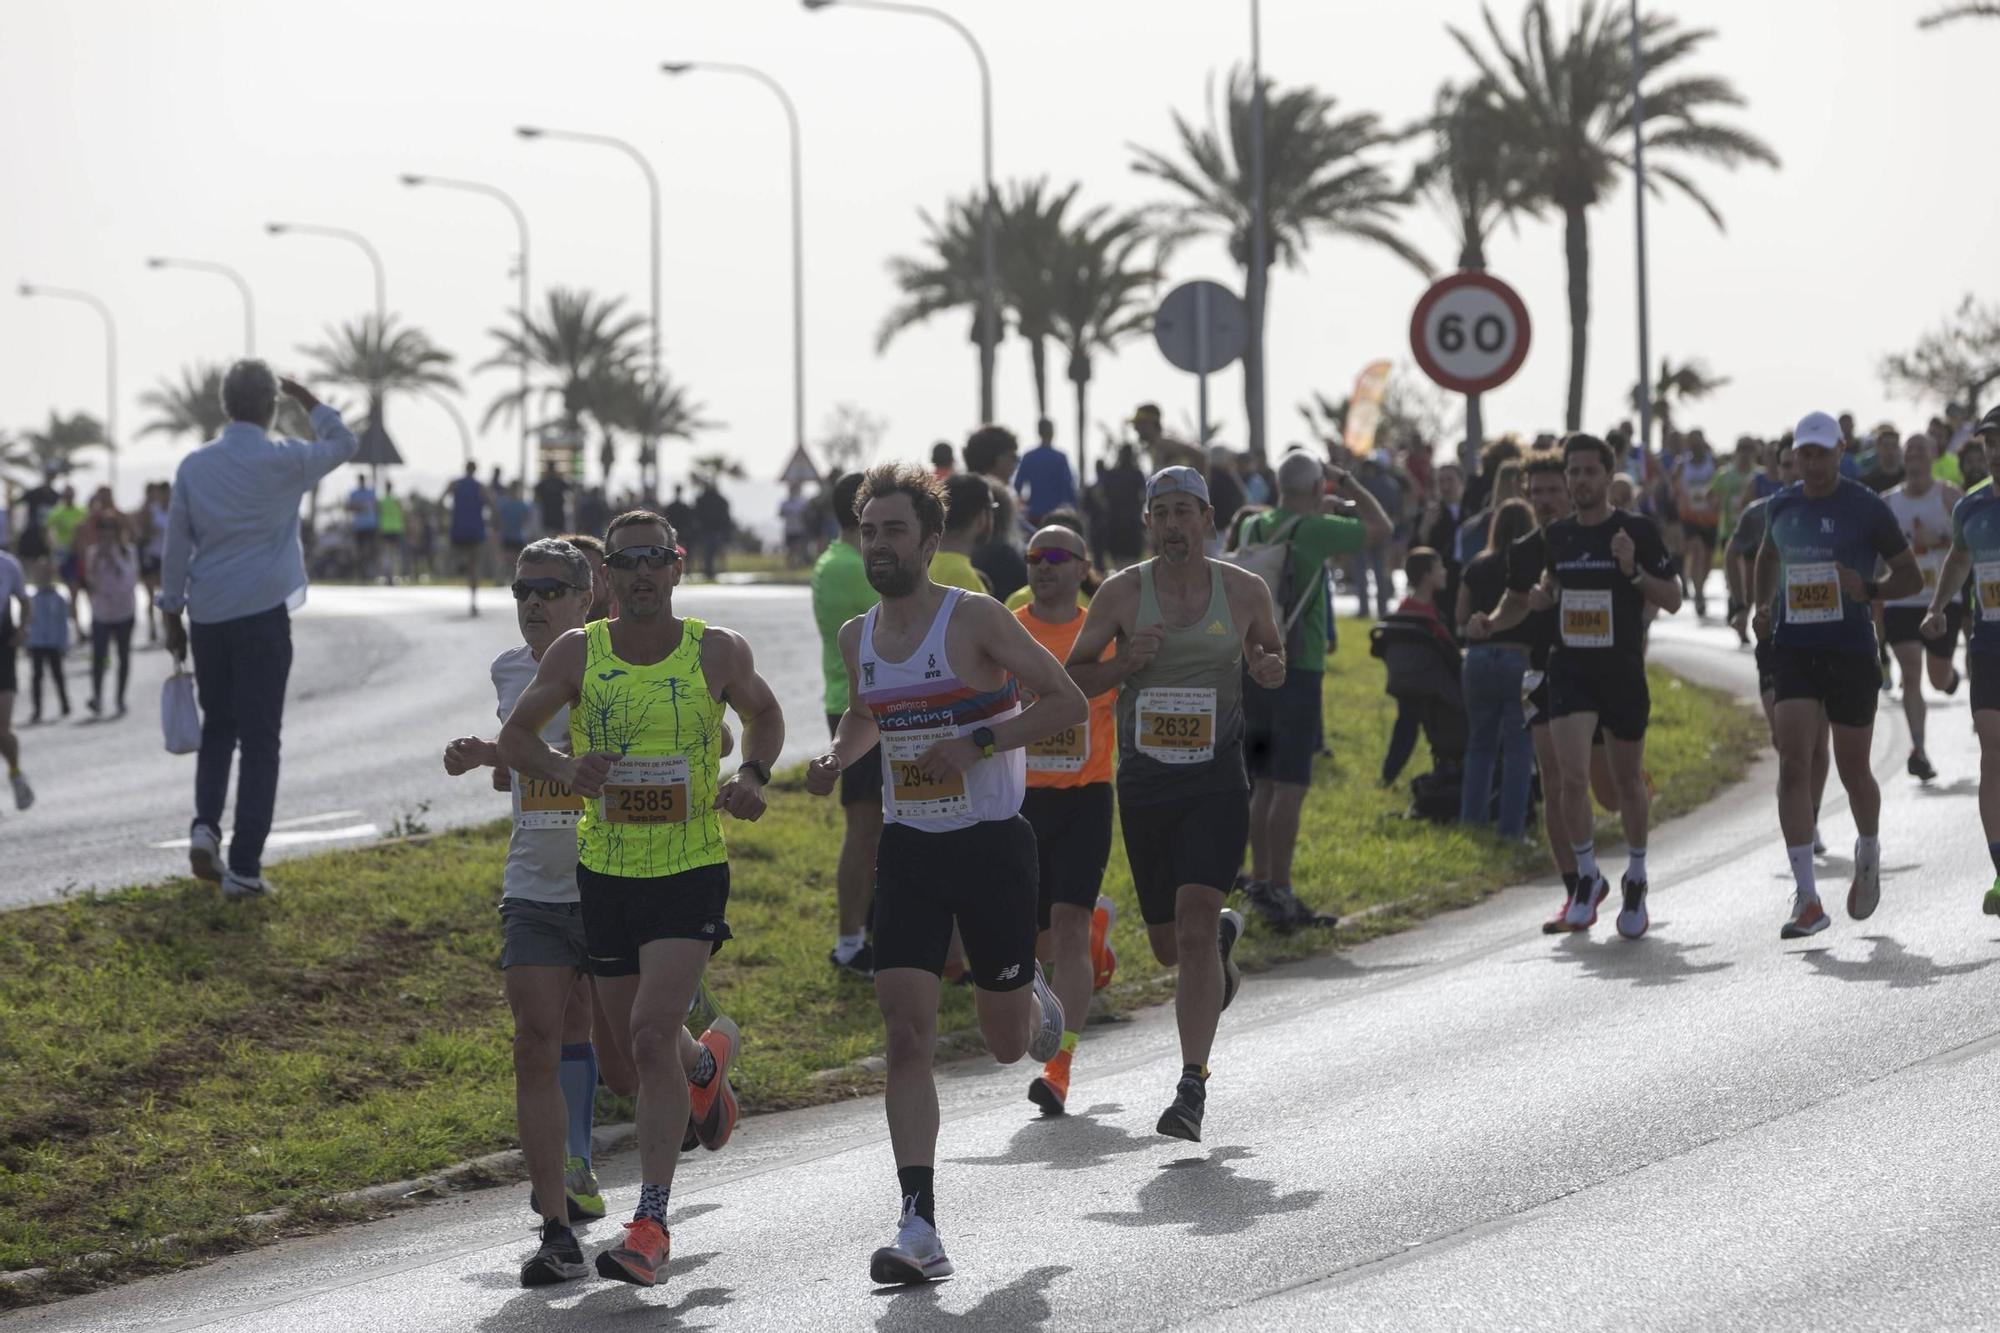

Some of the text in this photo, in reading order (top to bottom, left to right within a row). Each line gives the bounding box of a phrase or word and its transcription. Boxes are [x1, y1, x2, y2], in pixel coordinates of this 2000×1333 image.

[1438, 312, 1506, 353] 60
[887, 700, 928, 713] mallorca
[1153, 716, 1200, 737] 2632
[619, 789, 673, 811] 2585
